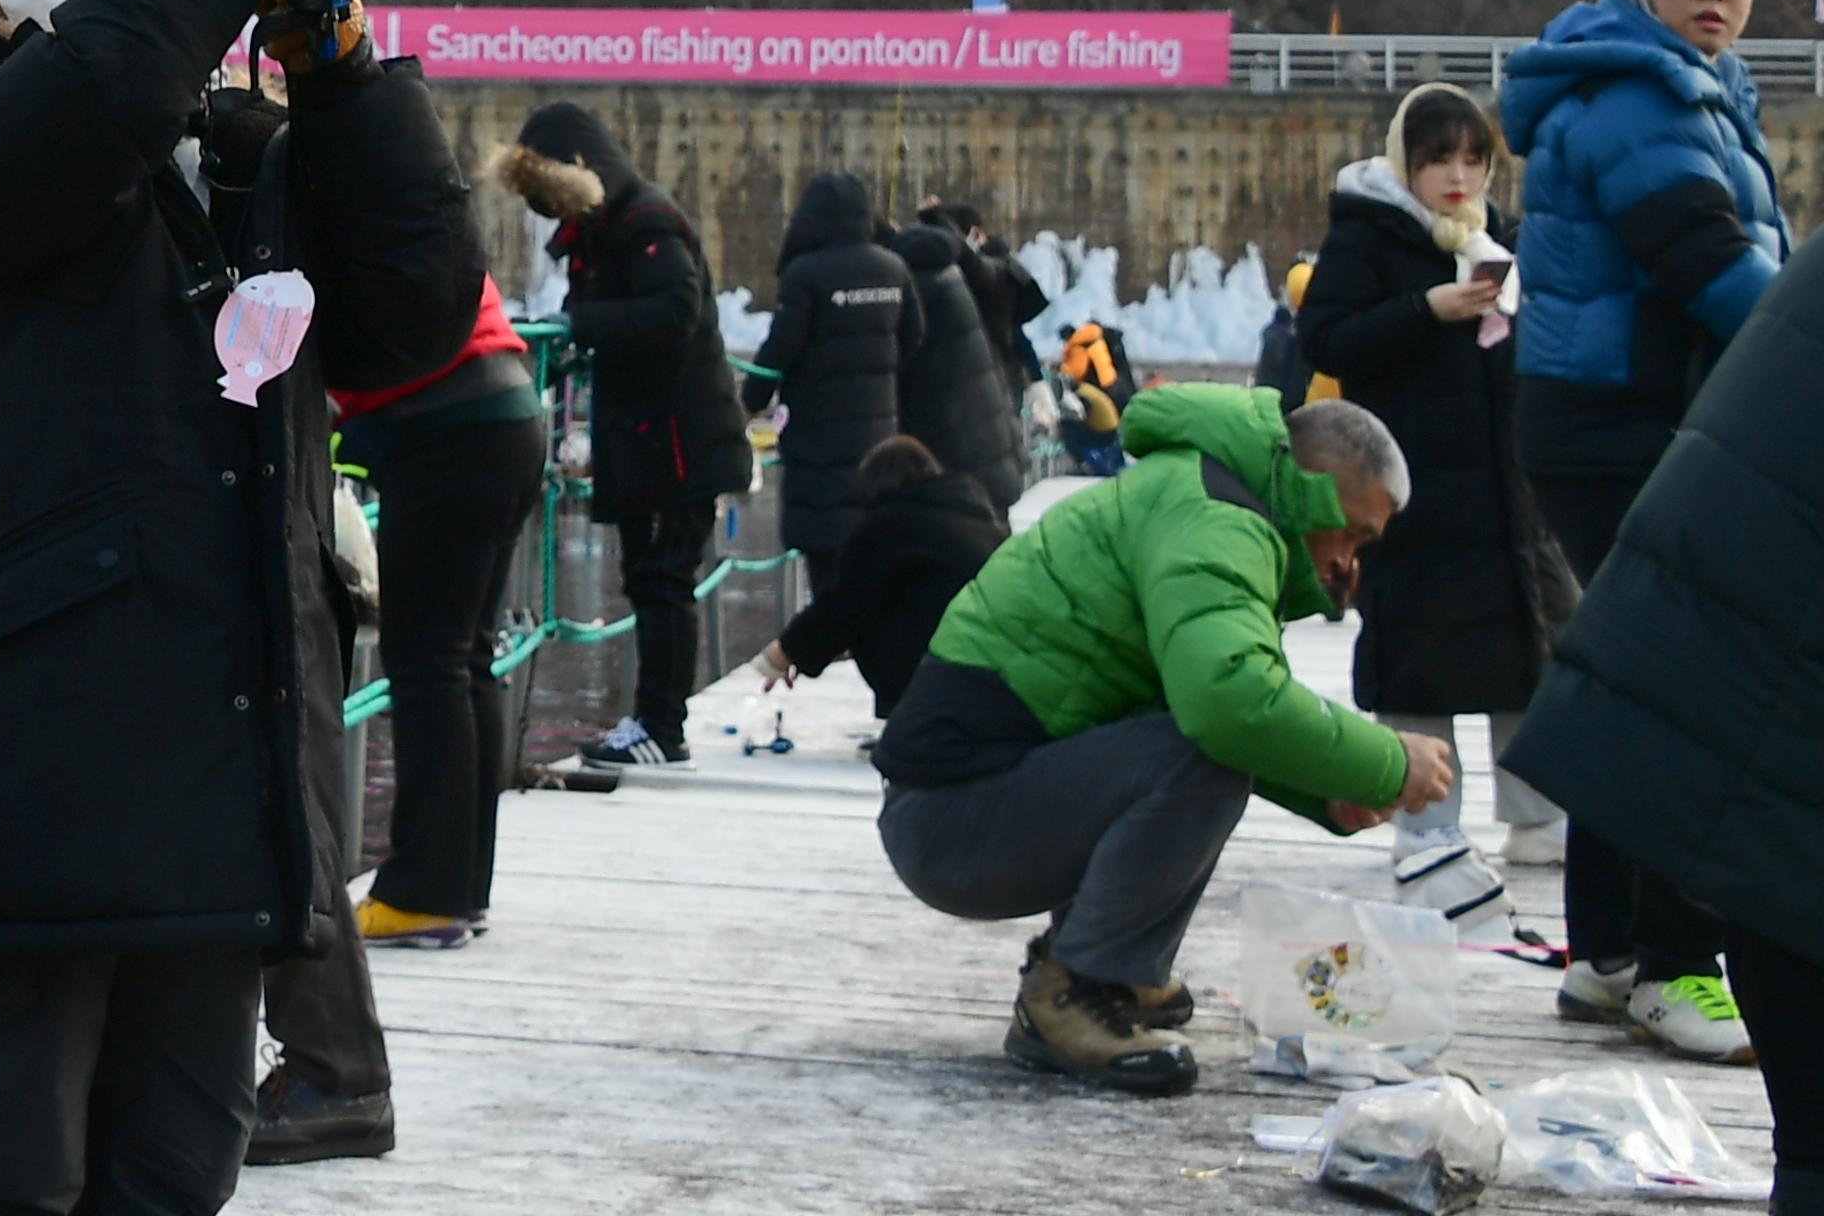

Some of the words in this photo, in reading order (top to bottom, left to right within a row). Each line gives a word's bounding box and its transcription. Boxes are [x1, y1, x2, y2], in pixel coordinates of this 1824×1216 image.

[426, 24, 635, 64] Sancheoneo
[641, 27, 753, 74] fishing
[759, 37, 804, 65] on
[810, 32, 947, 74] pontoon
[979, 31, 1061, 68] Lure
[1066, 31, 1181, 77] fishing
